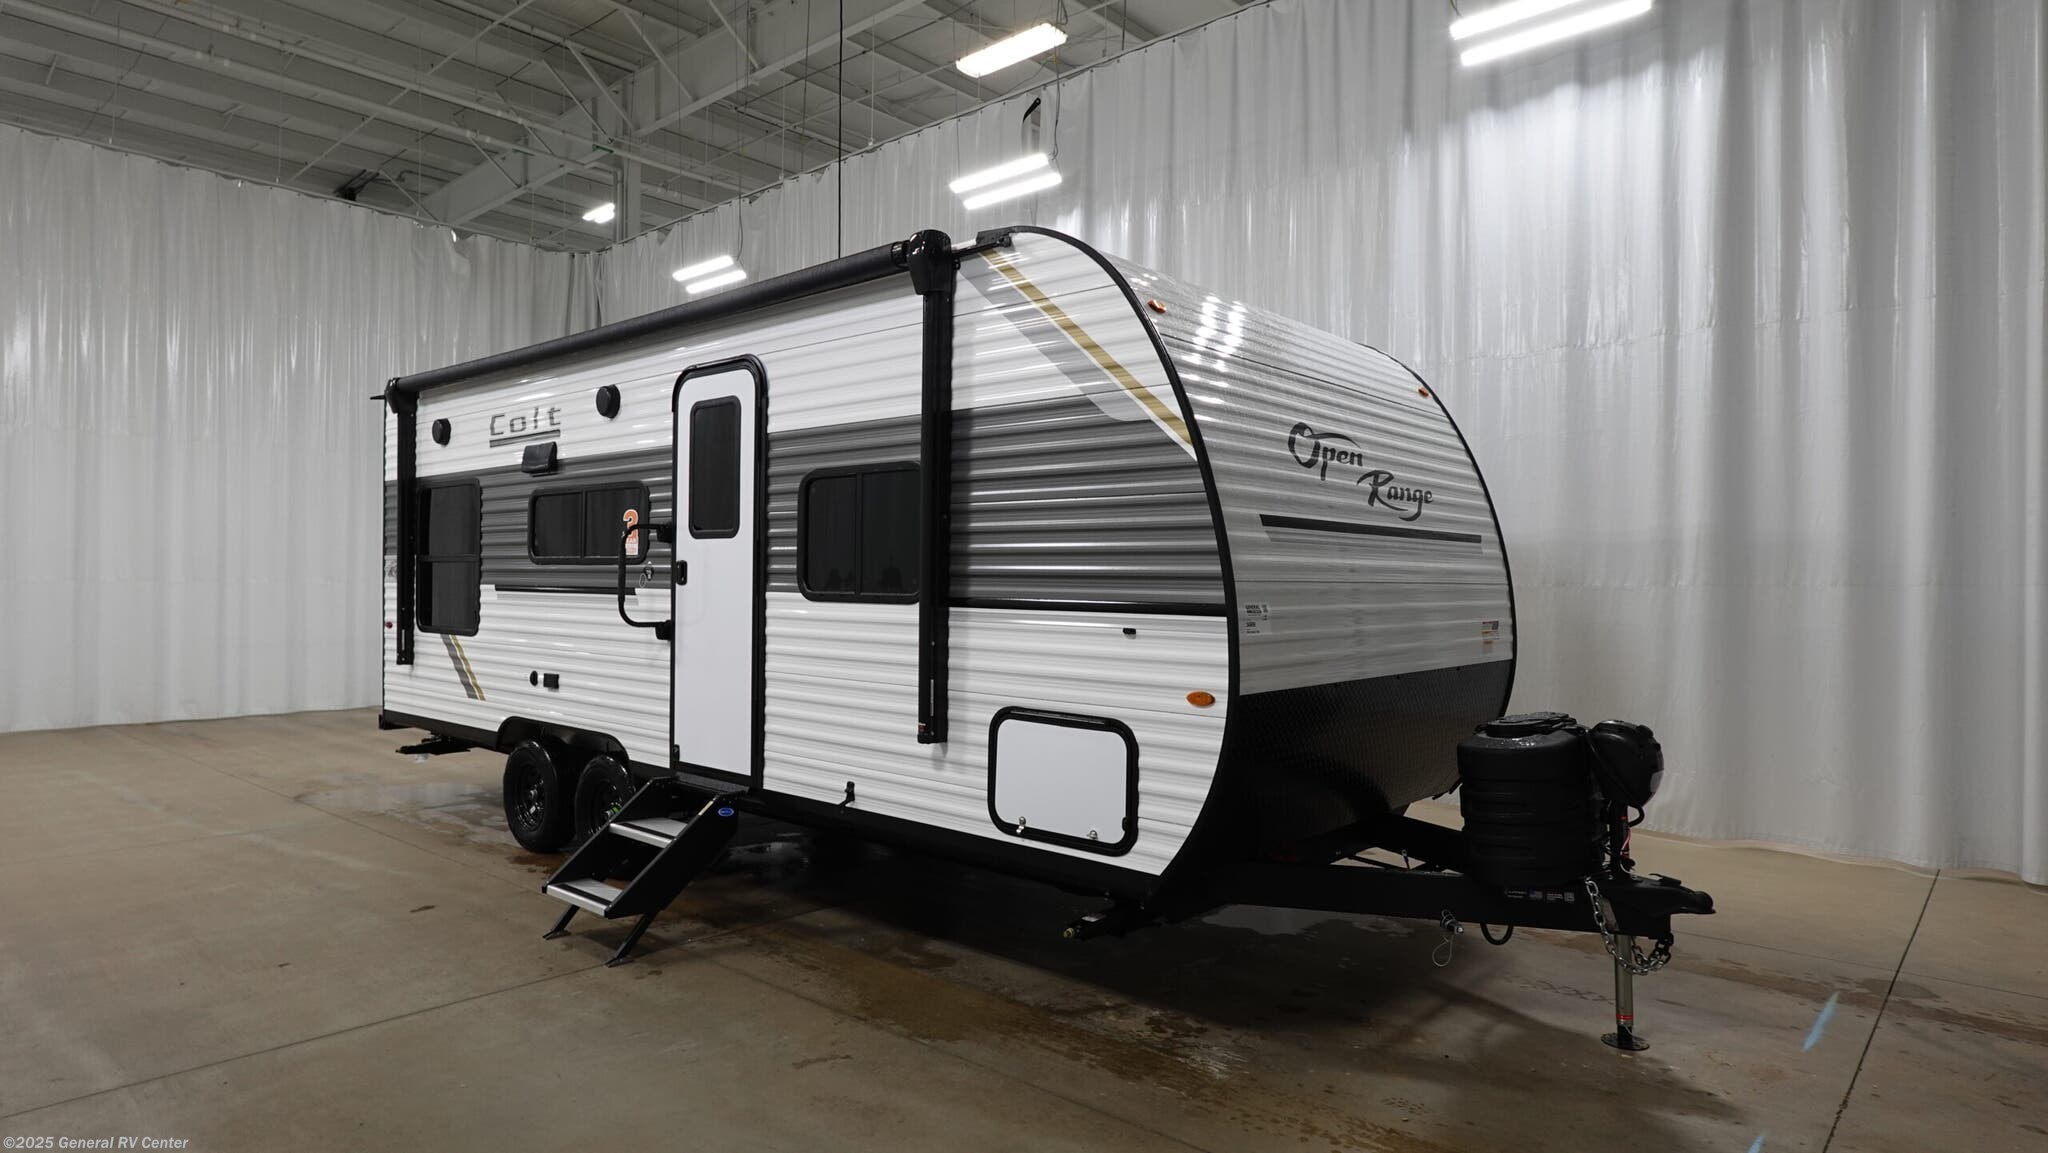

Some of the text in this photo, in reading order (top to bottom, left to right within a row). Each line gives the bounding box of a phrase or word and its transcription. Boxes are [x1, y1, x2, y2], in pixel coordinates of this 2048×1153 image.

[489, 407, 561, 436] Colt
[1288, 422, 1363, 481] Open
[1356, 470, 1433, 521] Range
